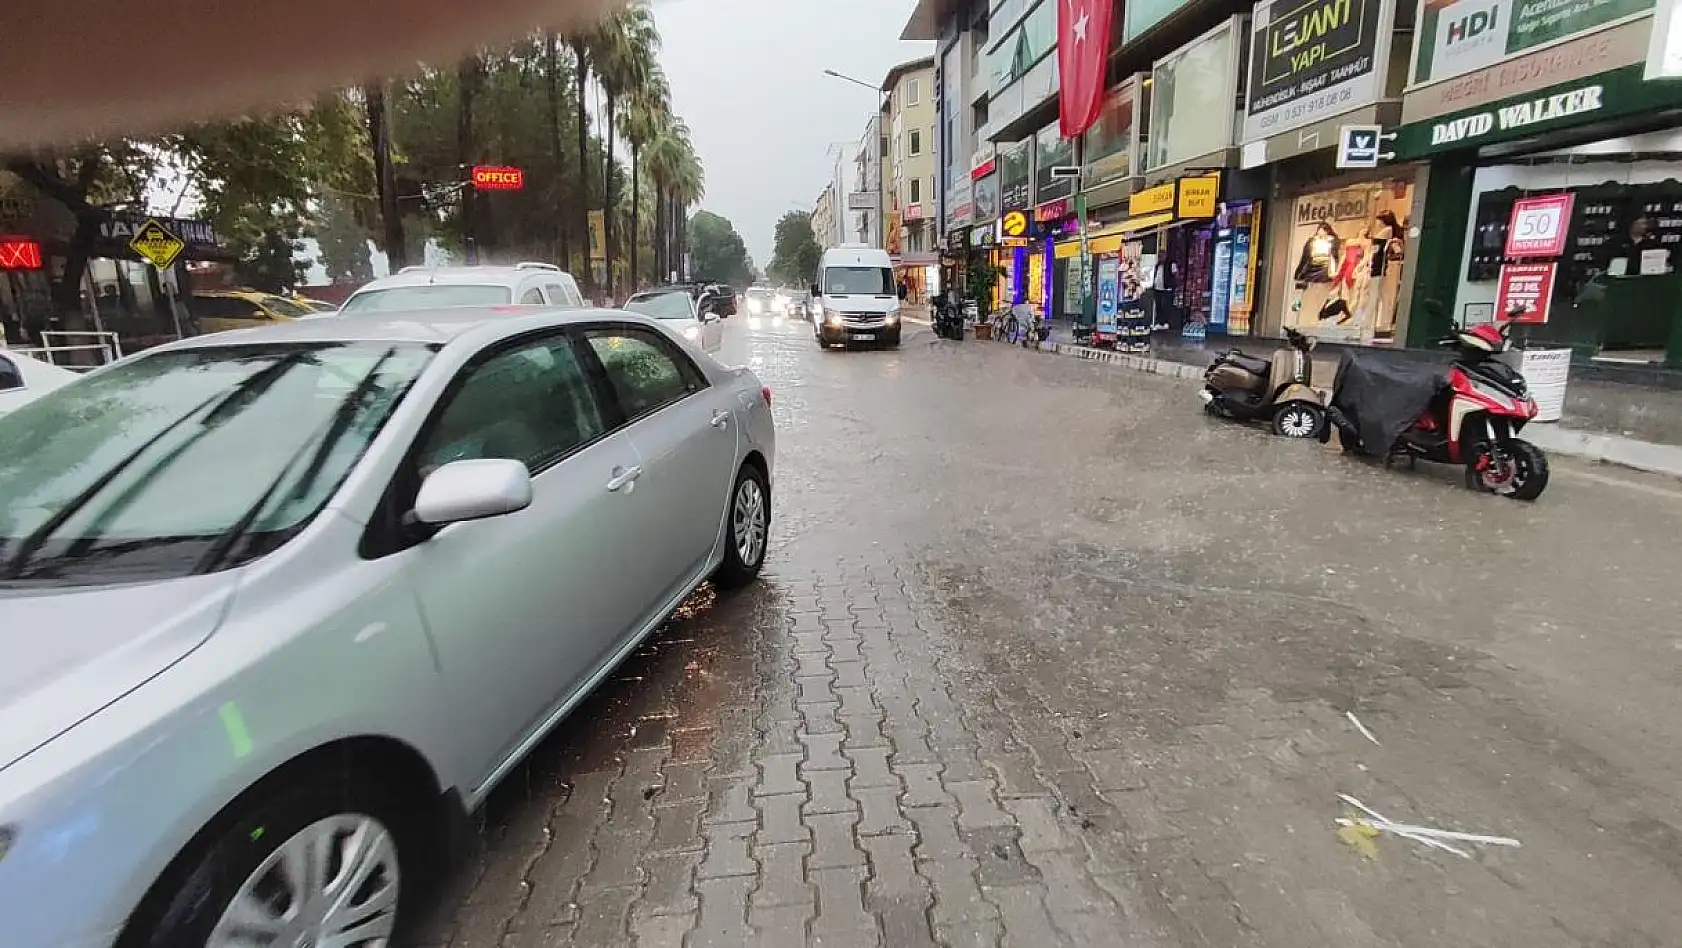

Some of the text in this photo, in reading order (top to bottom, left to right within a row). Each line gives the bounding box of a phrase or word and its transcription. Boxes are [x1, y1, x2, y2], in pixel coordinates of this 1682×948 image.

[1272, 0, 1352, 57] LEJANT
[1447, 4, 1499, 45] HDI
[1291, 42, 1327, 74] YAPI
[1431, 84, 1604, 146] DAVID WALKER
[476, 172, 518, 183] OFFICE
[1521, 213, 1551, 236] 50
